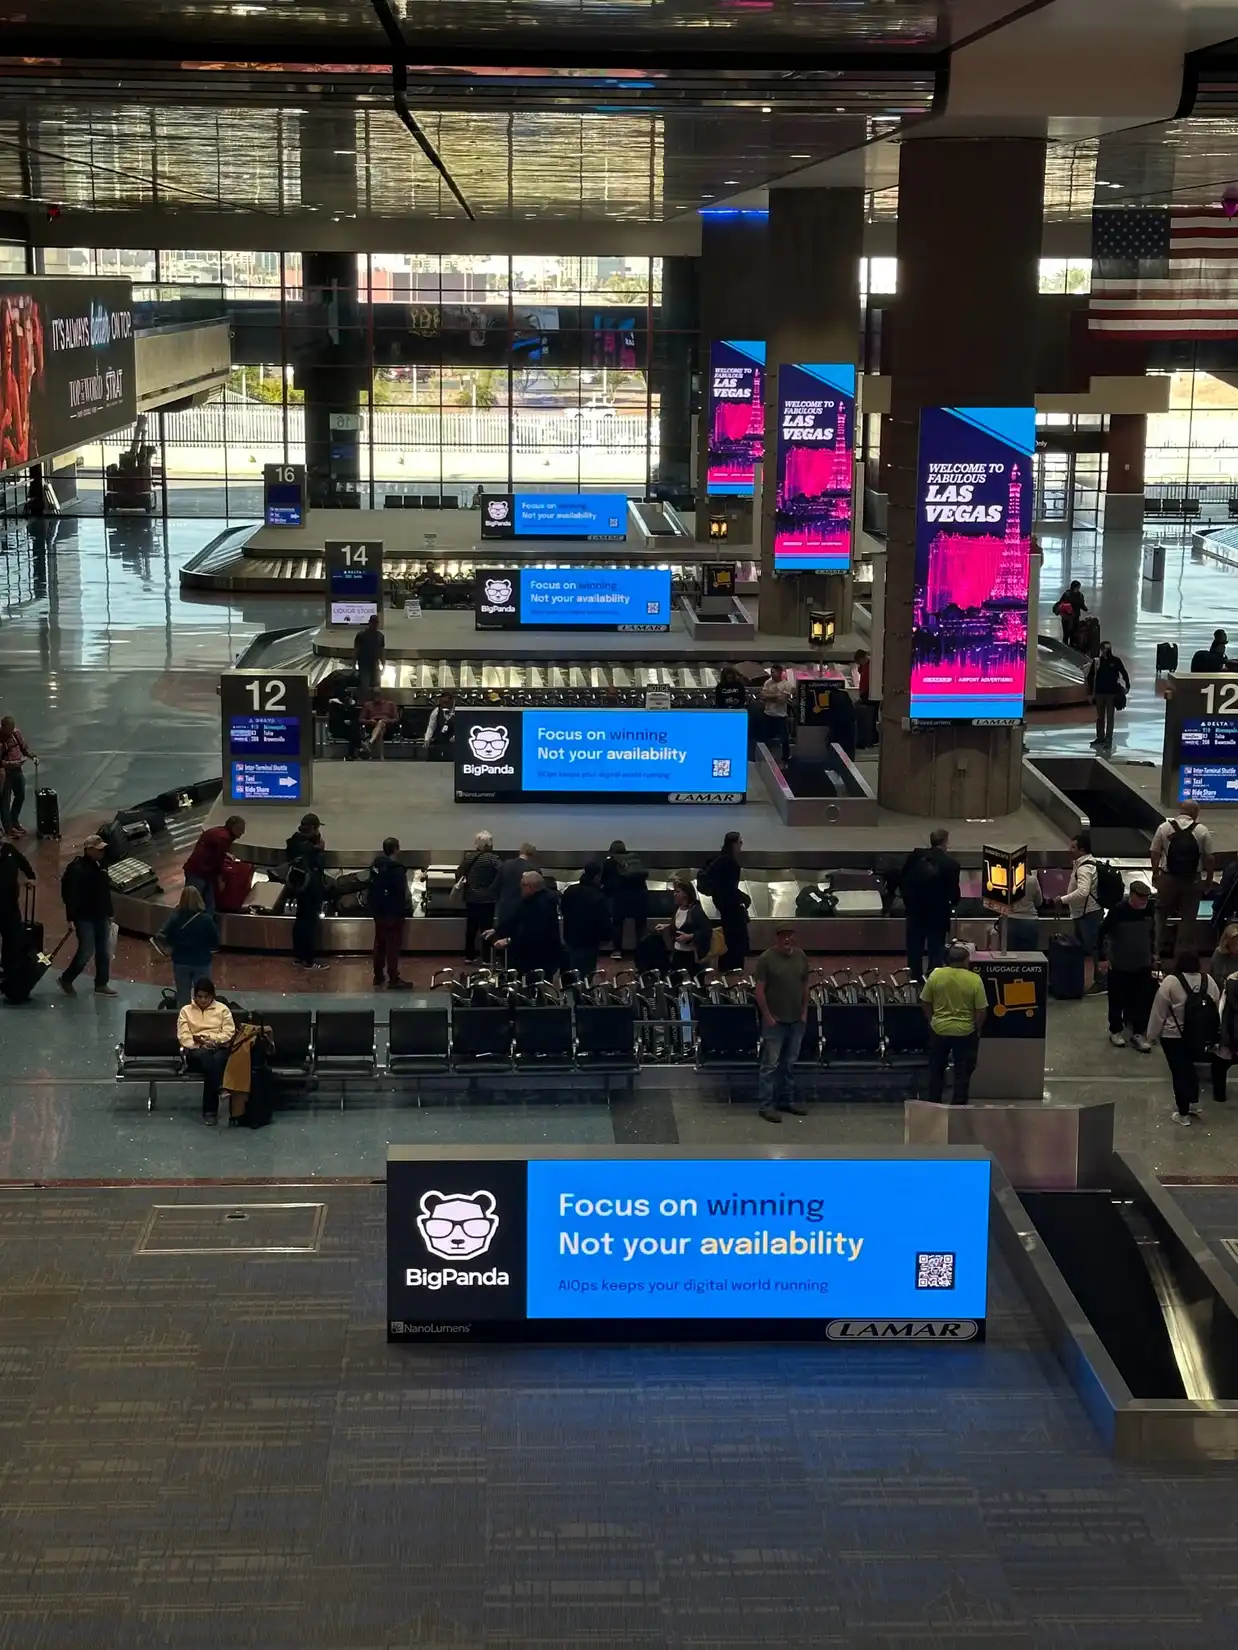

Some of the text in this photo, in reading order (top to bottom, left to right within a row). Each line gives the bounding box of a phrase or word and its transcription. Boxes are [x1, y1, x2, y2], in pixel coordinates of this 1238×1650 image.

[52, 318, 65, 351] IT'S
[66, 316, 90, 349] ALWAYS
[111, 312, 121, 340] ON
[106, 368, 123, 401] STRAT
[713, 379, 738, 388] LAS
[713, 388, 752, 398] VEGAS
[784, 400, 834, 408] WELCOME TO
[782, 415, 814, 427] LAS
[782, 428, 834, 440] VEGAS
[276, 466, 295, 482] 16
[929, 464, 1004, 473] WELCOME TO
[927, 474, 987, 483] FABULOUS
[925, 485, 974, 502] LAS
[522, 502, 544, 510] Focus
[926, 504, 1003, 522] VEGAS
[485, 520, 512, 528] BigPanda
[340, 545, 368, 566] 14
[530, 580, 560, 590] Focus
[563, 582, 576, 590] on
[530, 594, 630, 605] Not your availability
[481, 605, 516, 614] BigPanda
[245, 680, 286, 711] 12
[1200, 684, 1238, 714] 12
[538, 728, 668, 744] Focus on winning
[538, 746, 687, 764] Not your availability
[463, 764, 514, 776] BigPanda
[674, 794, 734, 802] LAMAR
[559, 1192, 825, 1223] Focus on winning
[559, 1230, 865, 1262] Not your availability
[406, 1267, 510, 1290] BigPanda
[602, 1279, 645, 1292] keeps
[650, 1282, 680, 1293] your
[684, 1279, 728, 1294] digital
[731, 1279, 771, 1291] world
[774, 1280, 829, 1294] running
[404, 1323, 470, 1334] NanoLumens
[839, 1322, 962, 1338] LAMAR
